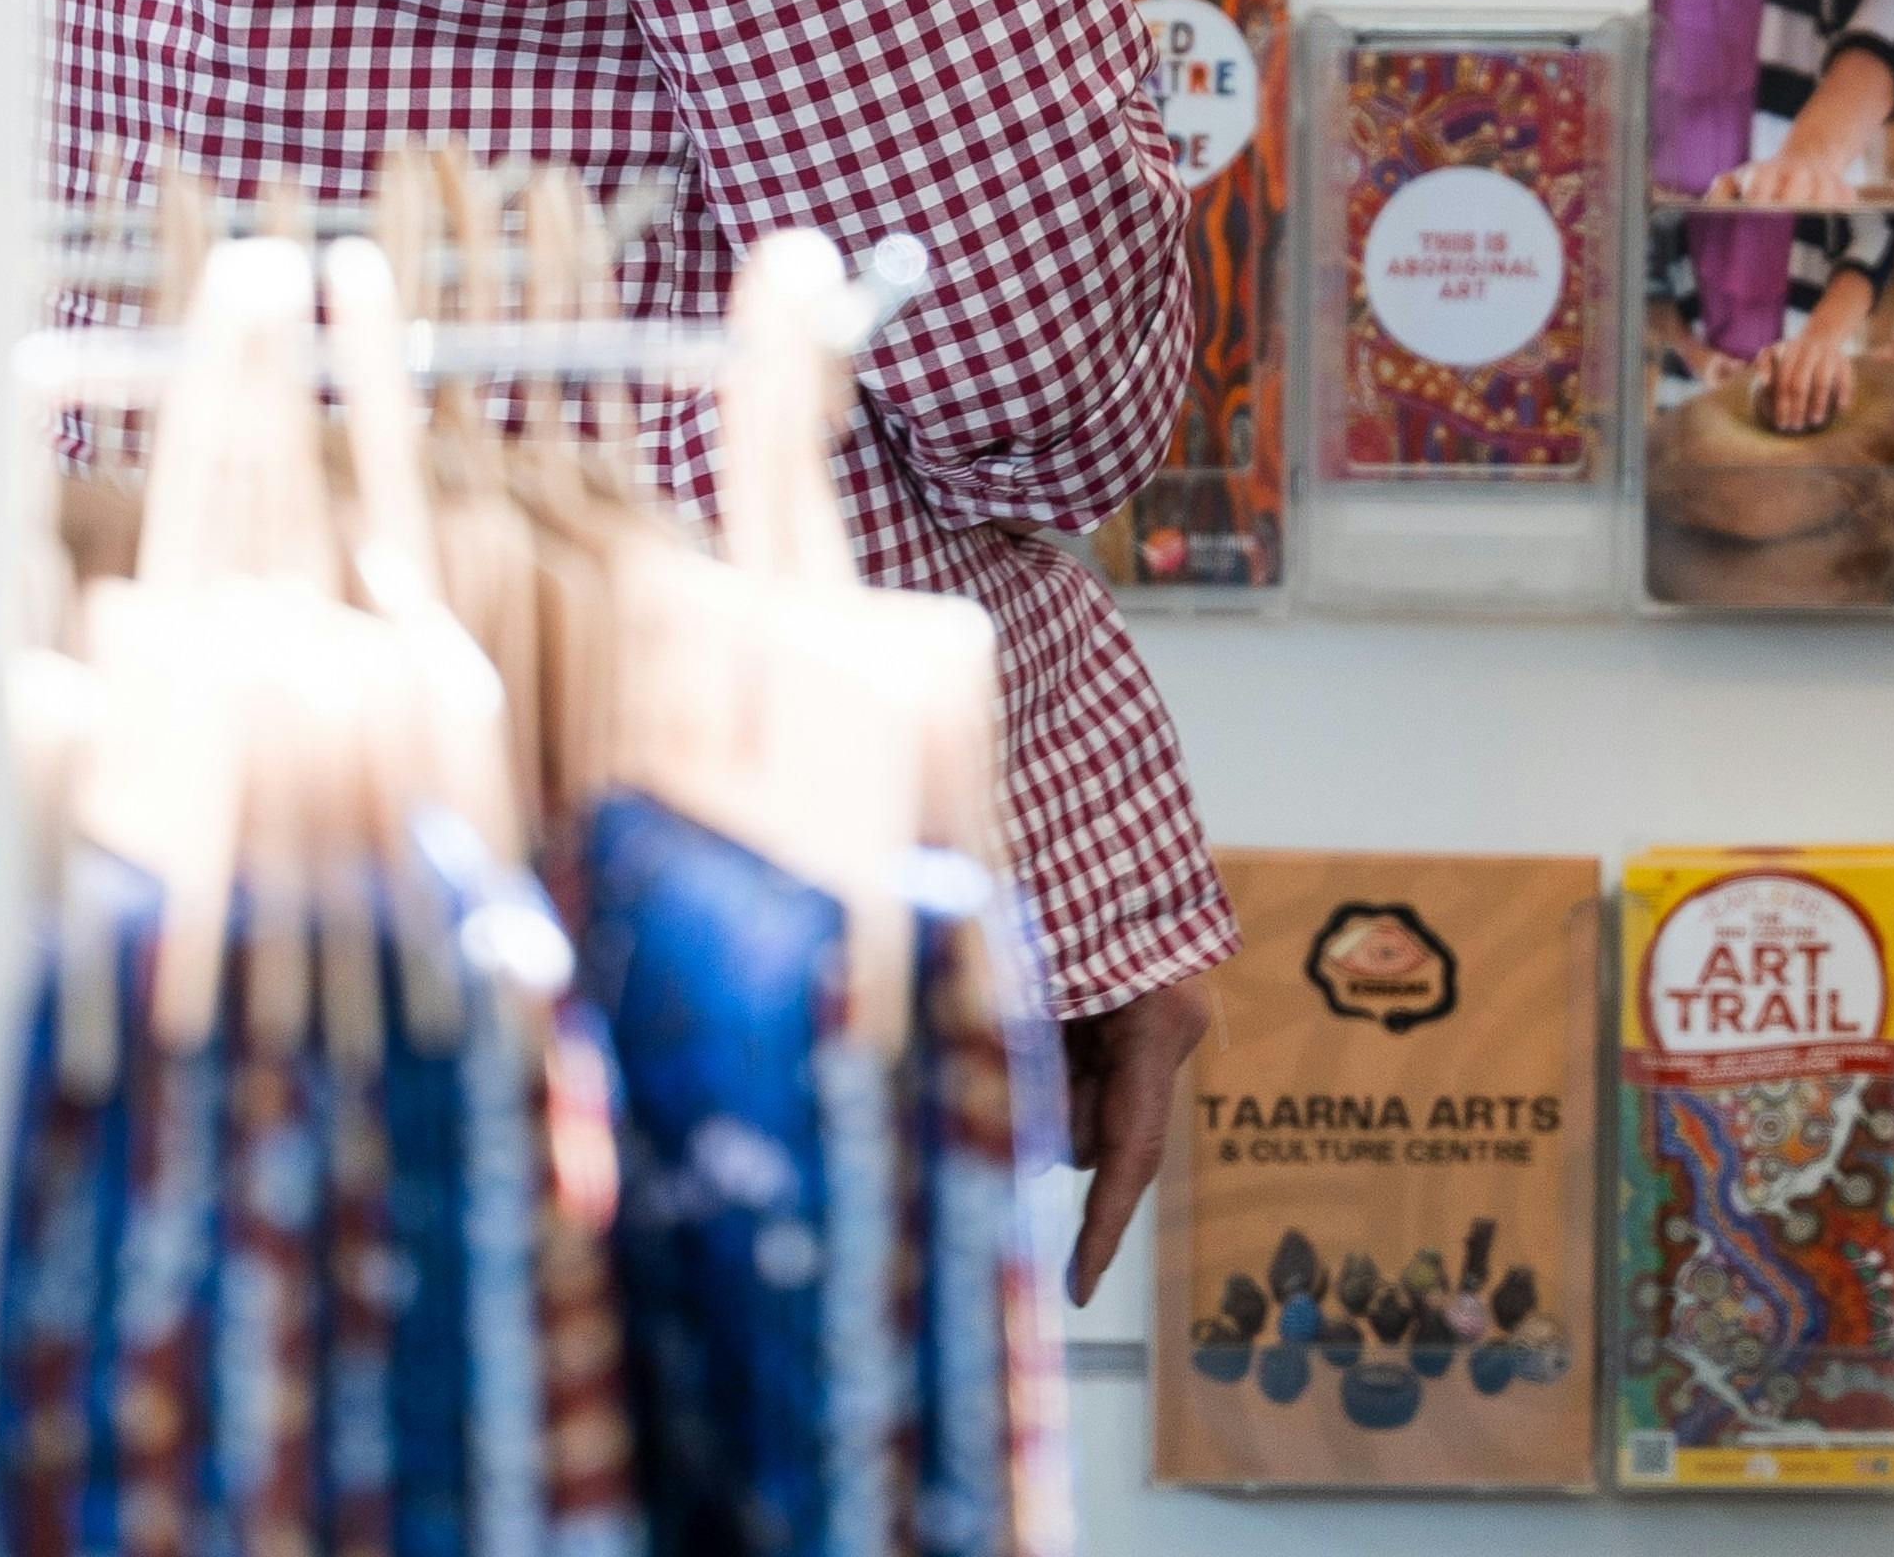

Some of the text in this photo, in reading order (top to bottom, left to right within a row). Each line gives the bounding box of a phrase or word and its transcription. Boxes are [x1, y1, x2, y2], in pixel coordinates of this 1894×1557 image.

[1419, 232, 1509, 256] THIS IS
[1387, 254, 1540, 279] ABORIGINAL
[1438, 278, 1487, 302] ART
[1699, 941, 1830, 990] ART
[1667, 987, 1861, 1039] TRAIL
[1195, 1094, 1561, 1133] TAARNA ARTS
[1249, 1139, 1395, 1164] CULTURE
[1404, 1140, 1532, 1165] CENTRE
